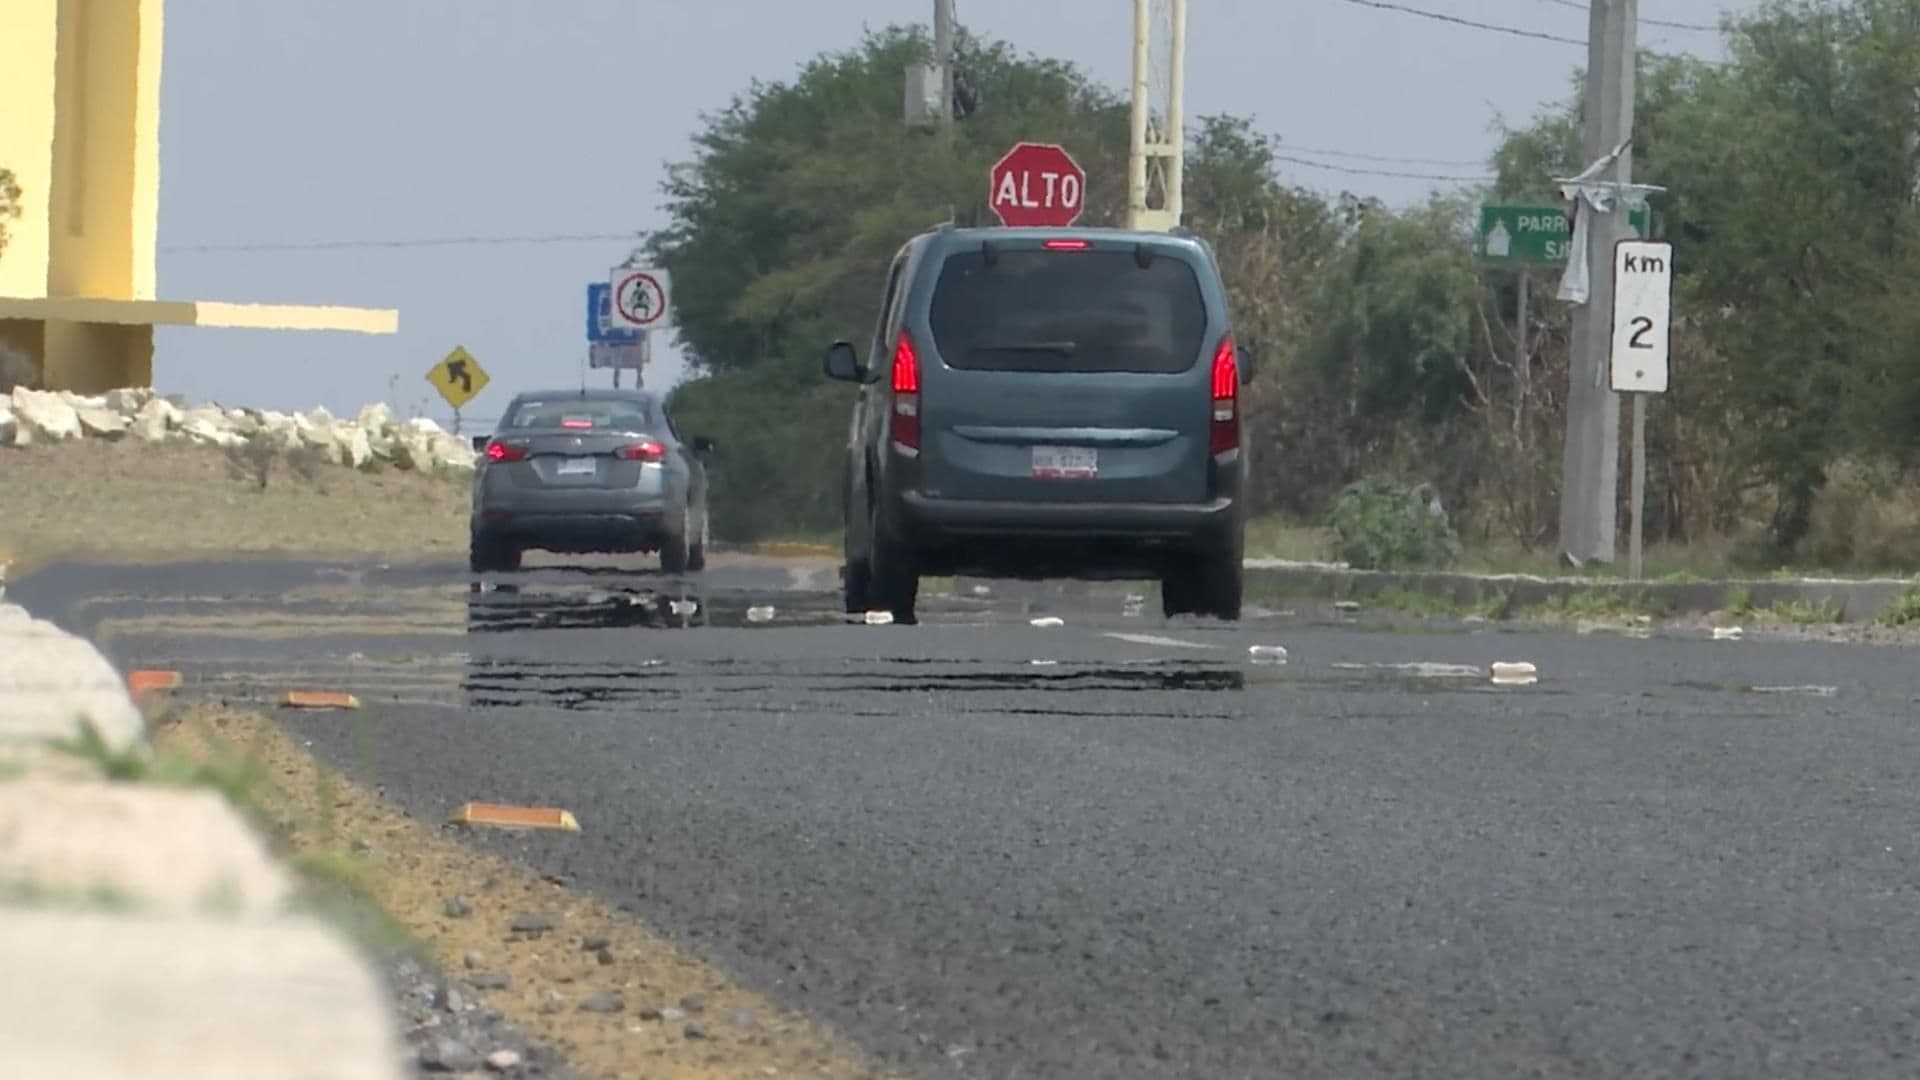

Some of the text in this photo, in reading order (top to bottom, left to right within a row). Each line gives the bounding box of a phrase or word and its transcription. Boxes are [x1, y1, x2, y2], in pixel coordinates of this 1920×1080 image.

[996, 171, 1079, 208] ALTO
[1518, 215, 1570, 232] PARR
[1624, 252, 1664, 273] km
[1629, 316, 1654, 349] 2
